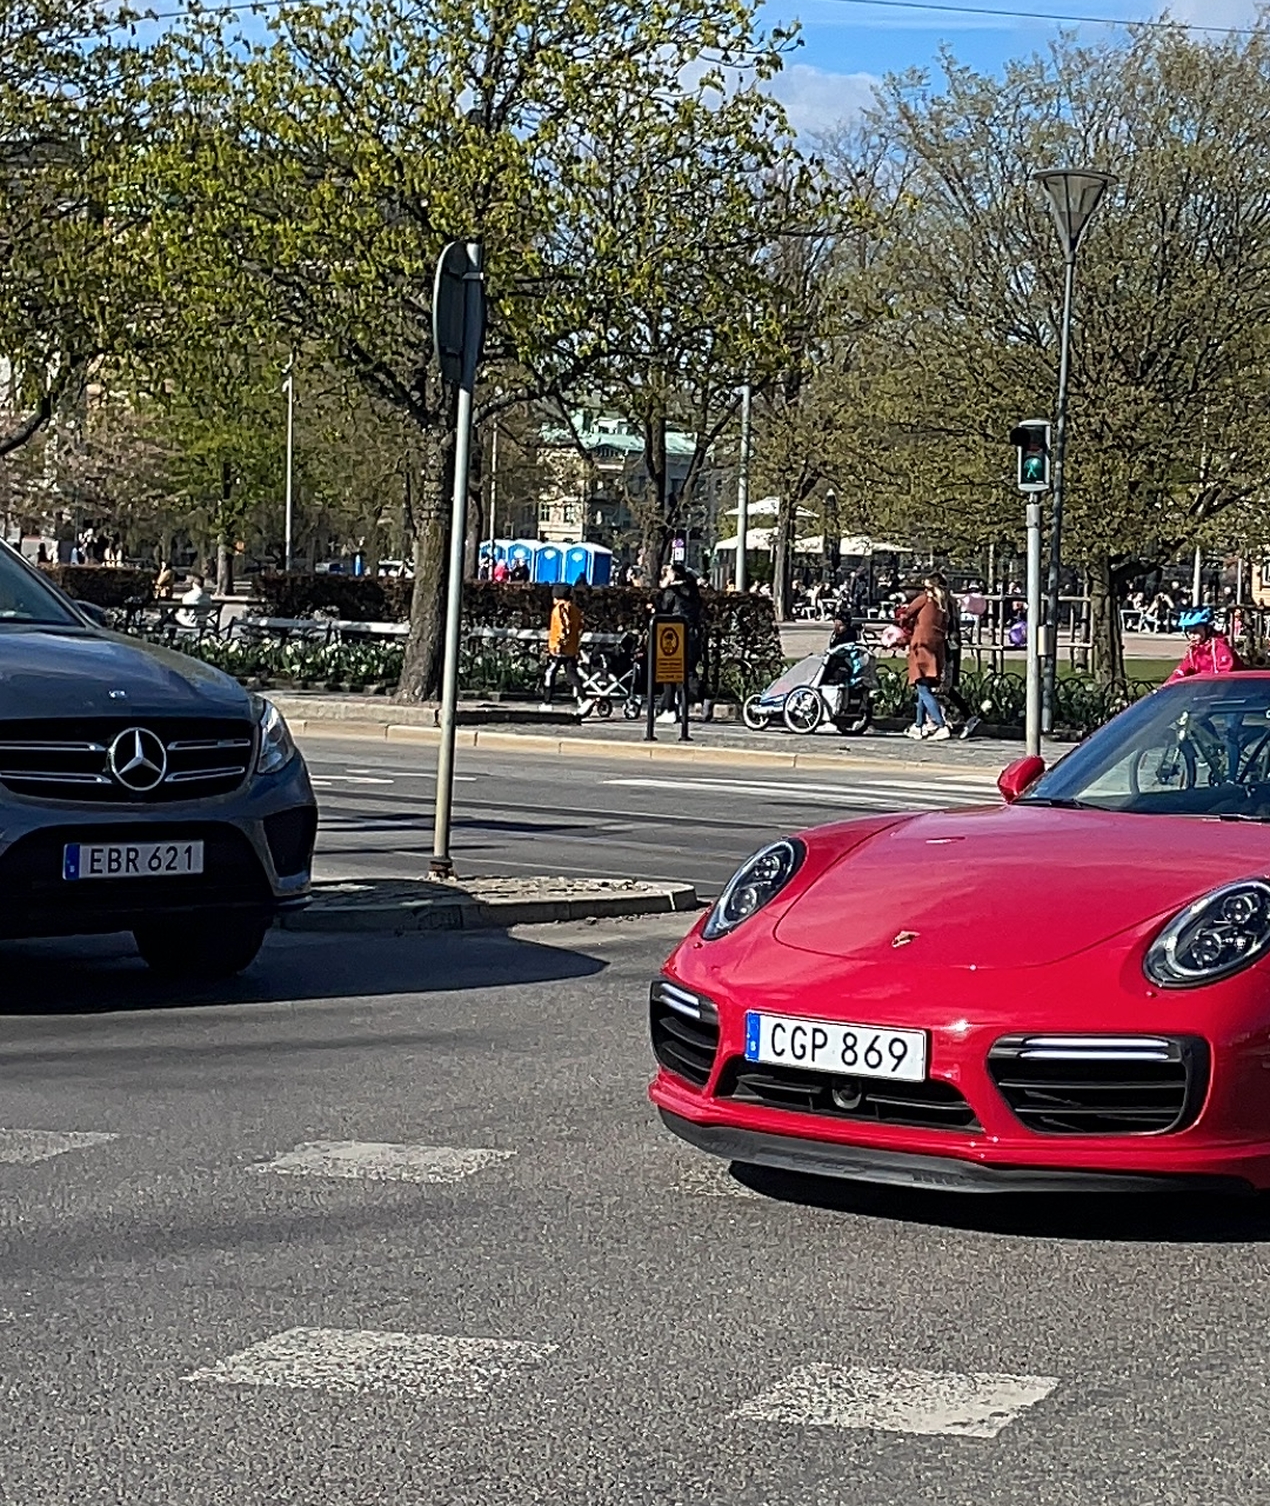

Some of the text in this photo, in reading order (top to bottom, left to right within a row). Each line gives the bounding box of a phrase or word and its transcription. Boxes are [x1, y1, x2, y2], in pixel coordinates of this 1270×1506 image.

[90, 845, 193, 873] EBR 621
[771, 1023, 908, 1072] CGP 869
